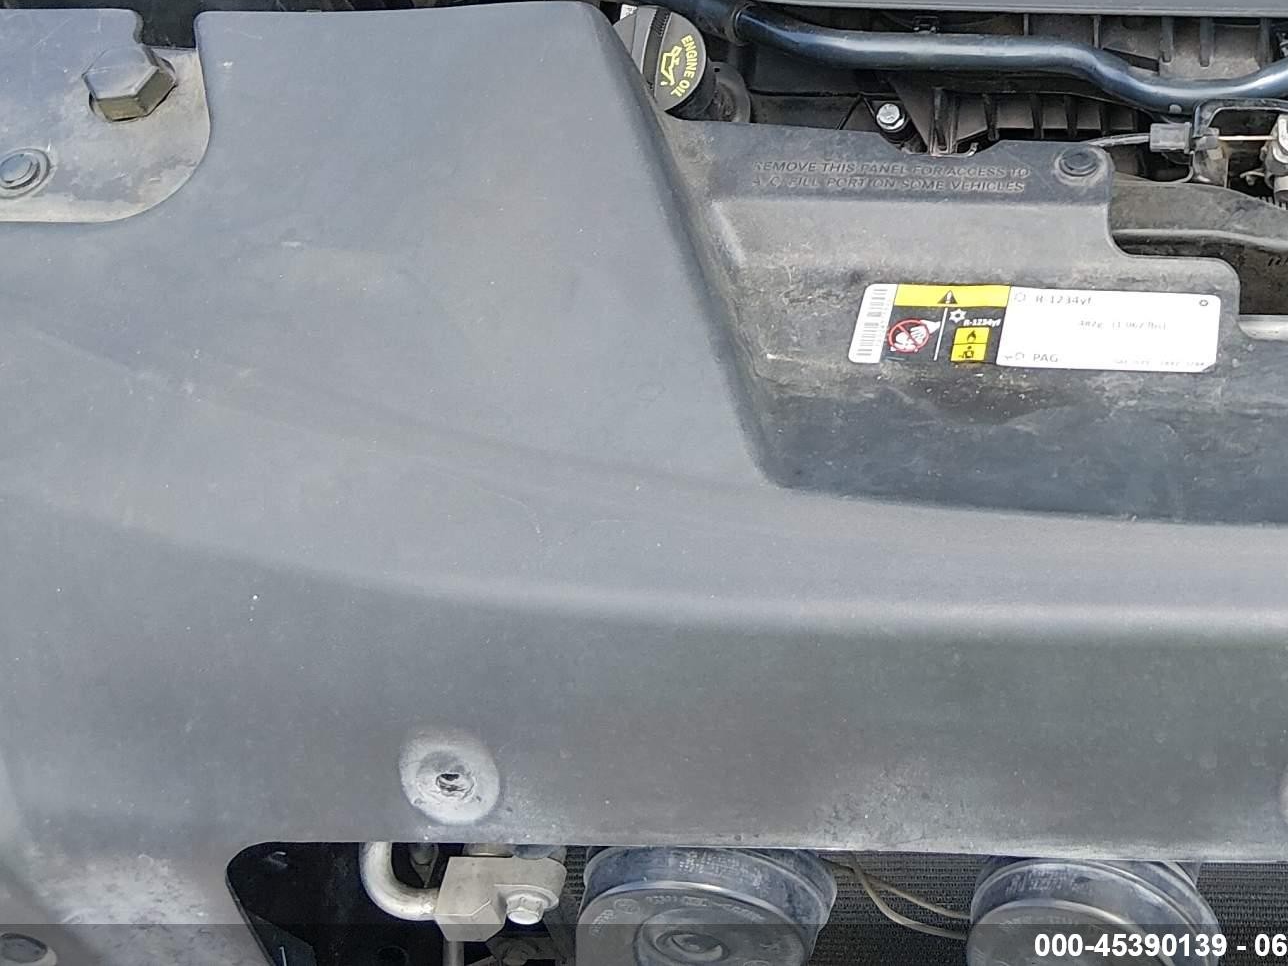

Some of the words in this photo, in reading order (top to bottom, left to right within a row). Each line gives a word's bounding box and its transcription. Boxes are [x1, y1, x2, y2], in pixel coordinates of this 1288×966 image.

[680, 34, 698, 78] ENGINE
[670, 79, 691, 97] OIL
[753, 161, 817, 172] REMOVE
[821, 162, 856, 173] THIS
[860, 163, 910, 175] PANEL
[912, 165, 944, 176] FOR
[945, 166, 1007, 178] ACCESS
[1010, 168, 1031, 179] TO
[787, 177, 819, 188] FILL
[903, 179, 945, 191] SOME
[950, 180, 1025, 192] VEHICLES
[1033, 353, 1059, 363] PAG
